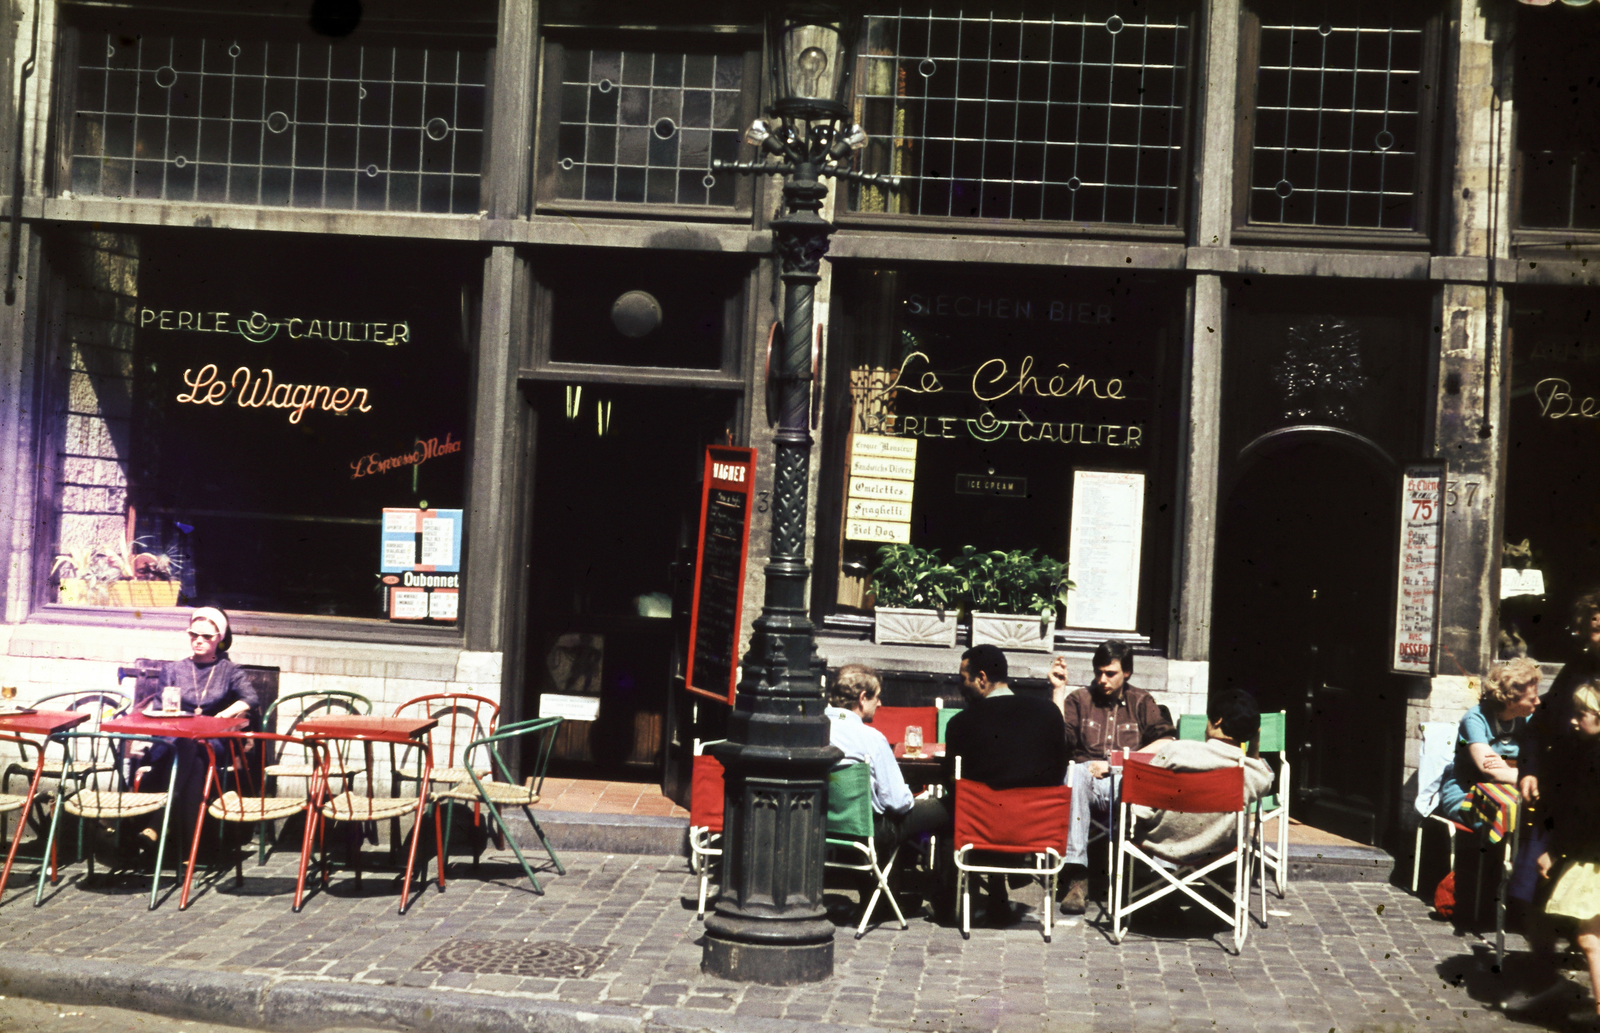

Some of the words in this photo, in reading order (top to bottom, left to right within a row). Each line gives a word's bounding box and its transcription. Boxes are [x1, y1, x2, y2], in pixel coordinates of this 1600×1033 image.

[908, 294, 1031, 319] SIECHEN
[1049, 300, 1111, 324] BIER
[141, 309, 231, 333] PERLE
[288, 317, 410, 343] CAULIER
[876, 351, 944, 398] Le
[972, 355, 1126, 401] Chêne
[176, 363, 227, 405] Le
[231, 366, 372, 424] Wagner
[1018, 420, 1143, 447] CAULIER
[879, 441, 914, 454] Monsieur
[712, 462, 746, 482] WAGNER
[889, 463, 913, 474] Divers
[967, 480, 982, 489] ICE
[984, 481, 1015, 491] CREAM
[1446, 480, 1482, 508] 37
[1412, 499, 1432, 520] 75
[852, 523, 871, 536] Hot
[404, 571, 460, 588] Dubonnet
[1408, 633, 1422, 641] AVEC
